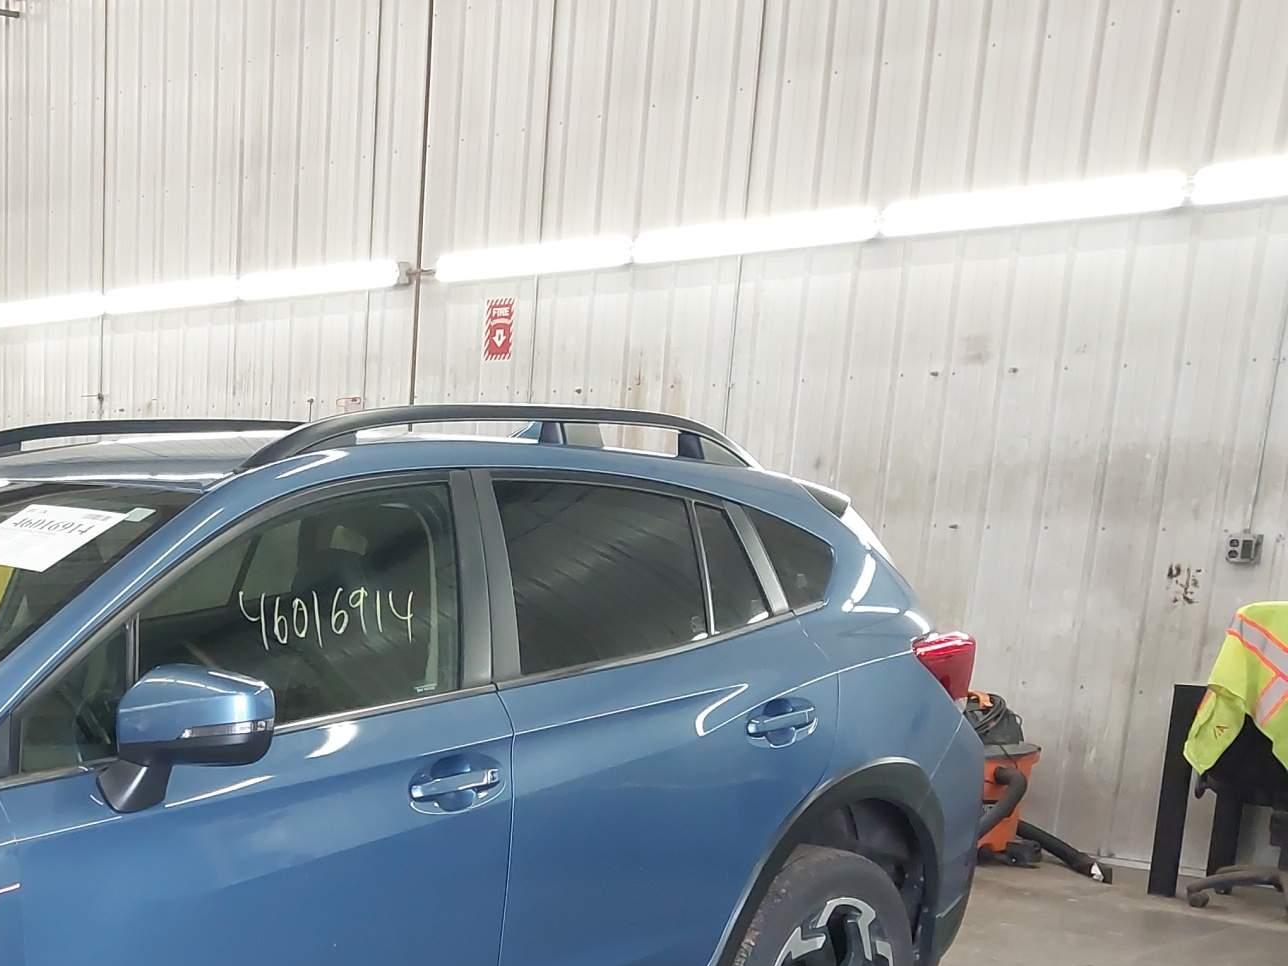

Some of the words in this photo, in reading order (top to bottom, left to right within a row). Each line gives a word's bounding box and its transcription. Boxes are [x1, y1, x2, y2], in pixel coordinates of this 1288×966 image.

[492, 307, 510, 317] FIRE
[12, 517, 96, 535] 46016914
[238, 586, 414, 651] 46016914
